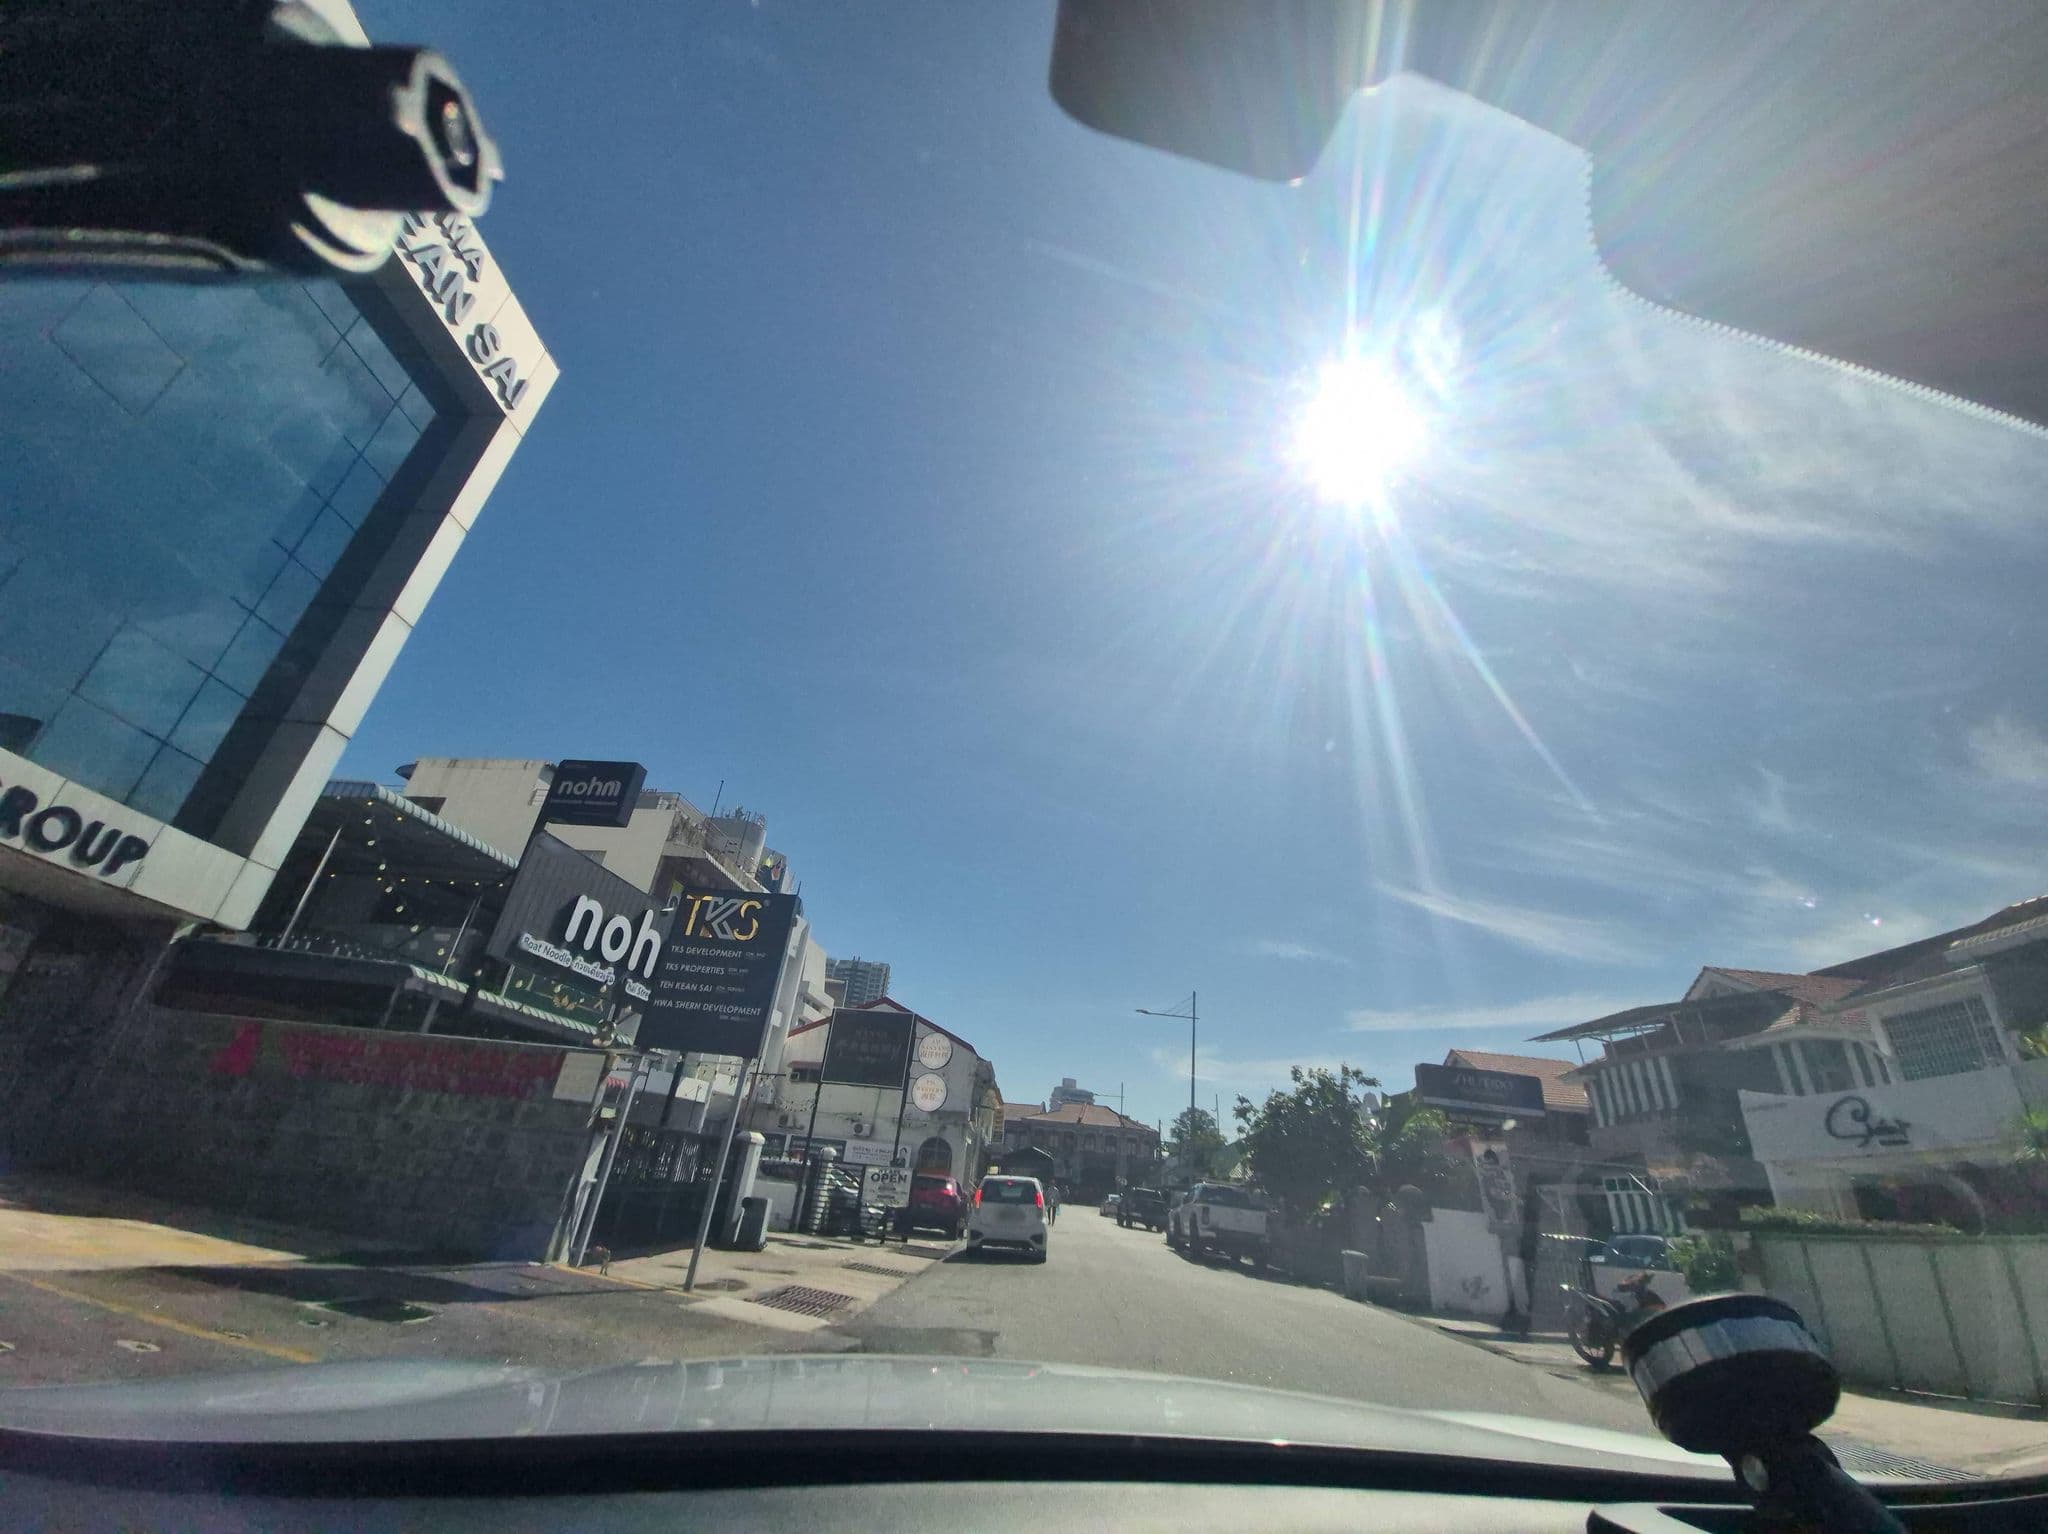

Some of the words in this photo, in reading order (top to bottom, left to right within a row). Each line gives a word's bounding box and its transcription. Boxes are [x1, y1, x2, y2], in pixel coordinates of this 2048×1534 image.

[466, 322, 529, 410] SAI
[558, 776, 621, 797] nohm
[0, 778, 149, 877] ROUP
[684, 894, 762, 941] TKS
[543, 946, 571, 967] Noodle
[671, 945, 684, 954] TKS
[685, 946, 743, 958] DEVELOPMENT
[665, 963, 679, 971] TKS
[680, 963, 725, 975] PROPERTIES
[660, 981, 674, 989] TEH
[675, 982, 697, 991] KEAN
[699, 983, 713, 992] SAI
[653, 999, 673, 1008] HWA
[674, 1000, 701, 1010] SHERN
[702, 1002, 762, 1016] DEVELOPMENT
[871, 1172, 908, 1184] OPEN
